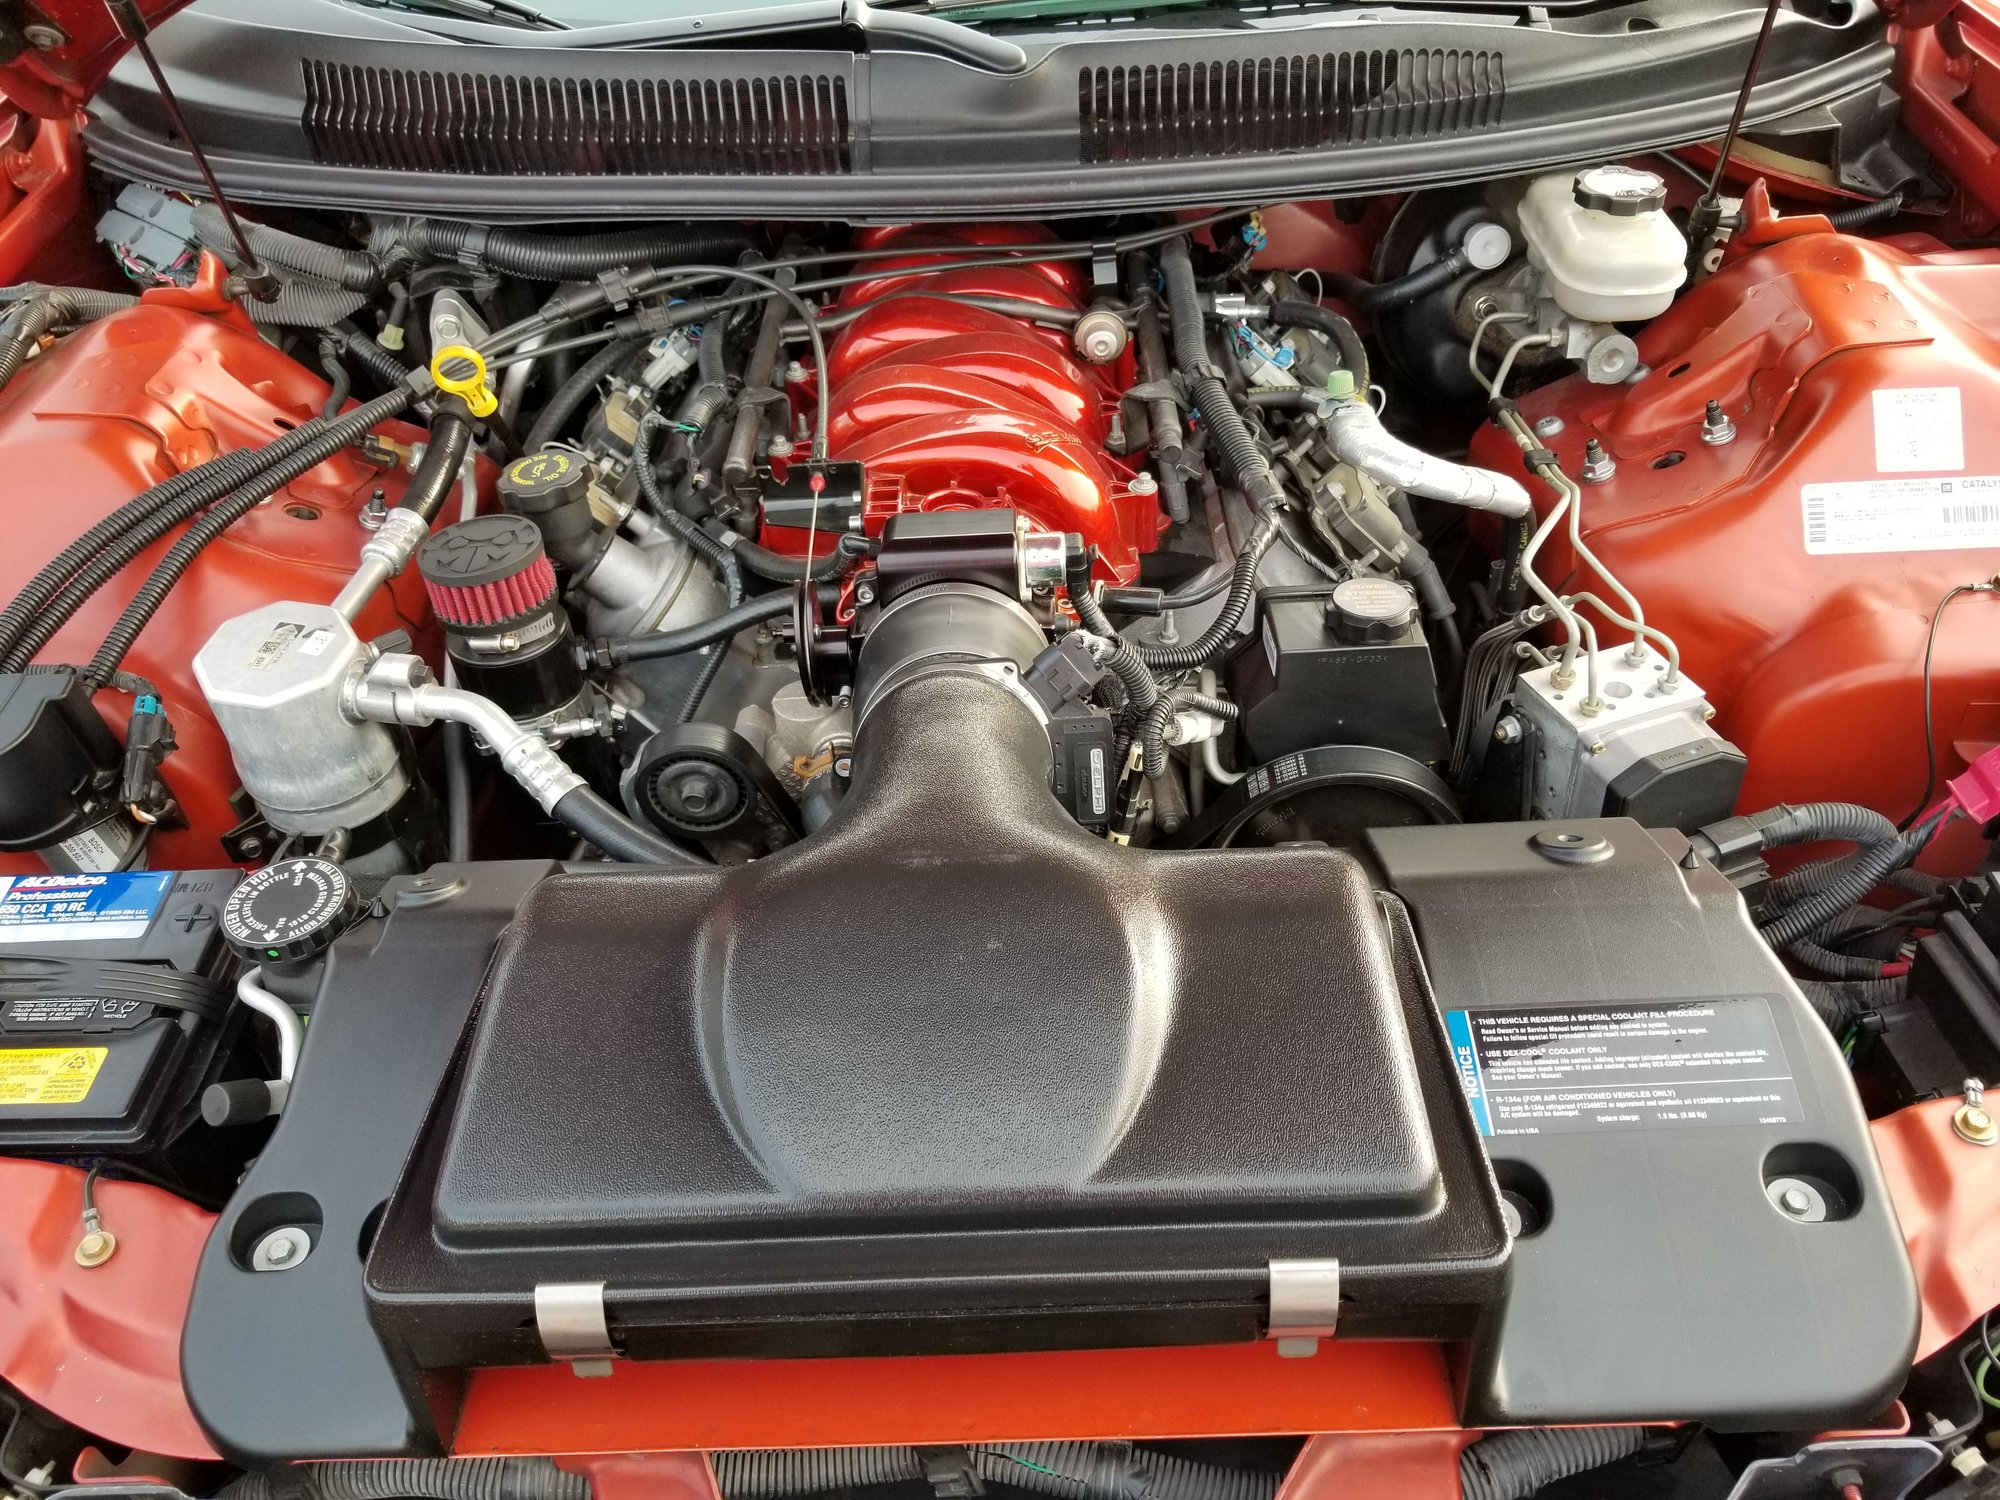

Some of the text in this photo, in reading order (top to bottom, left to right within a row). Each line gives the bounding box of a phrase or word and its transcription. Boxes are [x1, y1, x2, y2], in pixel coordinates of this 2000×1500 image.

[1962, 479, 2000, 489] CATALY
[8, 889, 93, 901] Professional
[242, 872, 290, 931] CHECK LEVEL IN BOTTLE
[21, 903, 47, 914] CCA
[51, 902, 67, 913] 90
[67, 901, 87, 912] RC
[226, 867, 275, 938] NEVER OPEN HOT
[289, 920, 318, 938] ALIGN
[316, 895, 341, 922] ARROW
[1612, 1012, 1648, 1020] COOLANT
[1667, 1009, 1715, 1018] PROCEDURE
[1548, 1047, 1586, 1055] COOLANT
[1457, 1046, 1480, 1098] NOTICE
[1523, 1095, 1541, 1103] (FOR
[1558, 1092, 1612, 1101] CONDITIONED
[1612, 1091, 1651, 1099] VEHICLES
[1652, 1090, 1676, 1098] ONLY)
